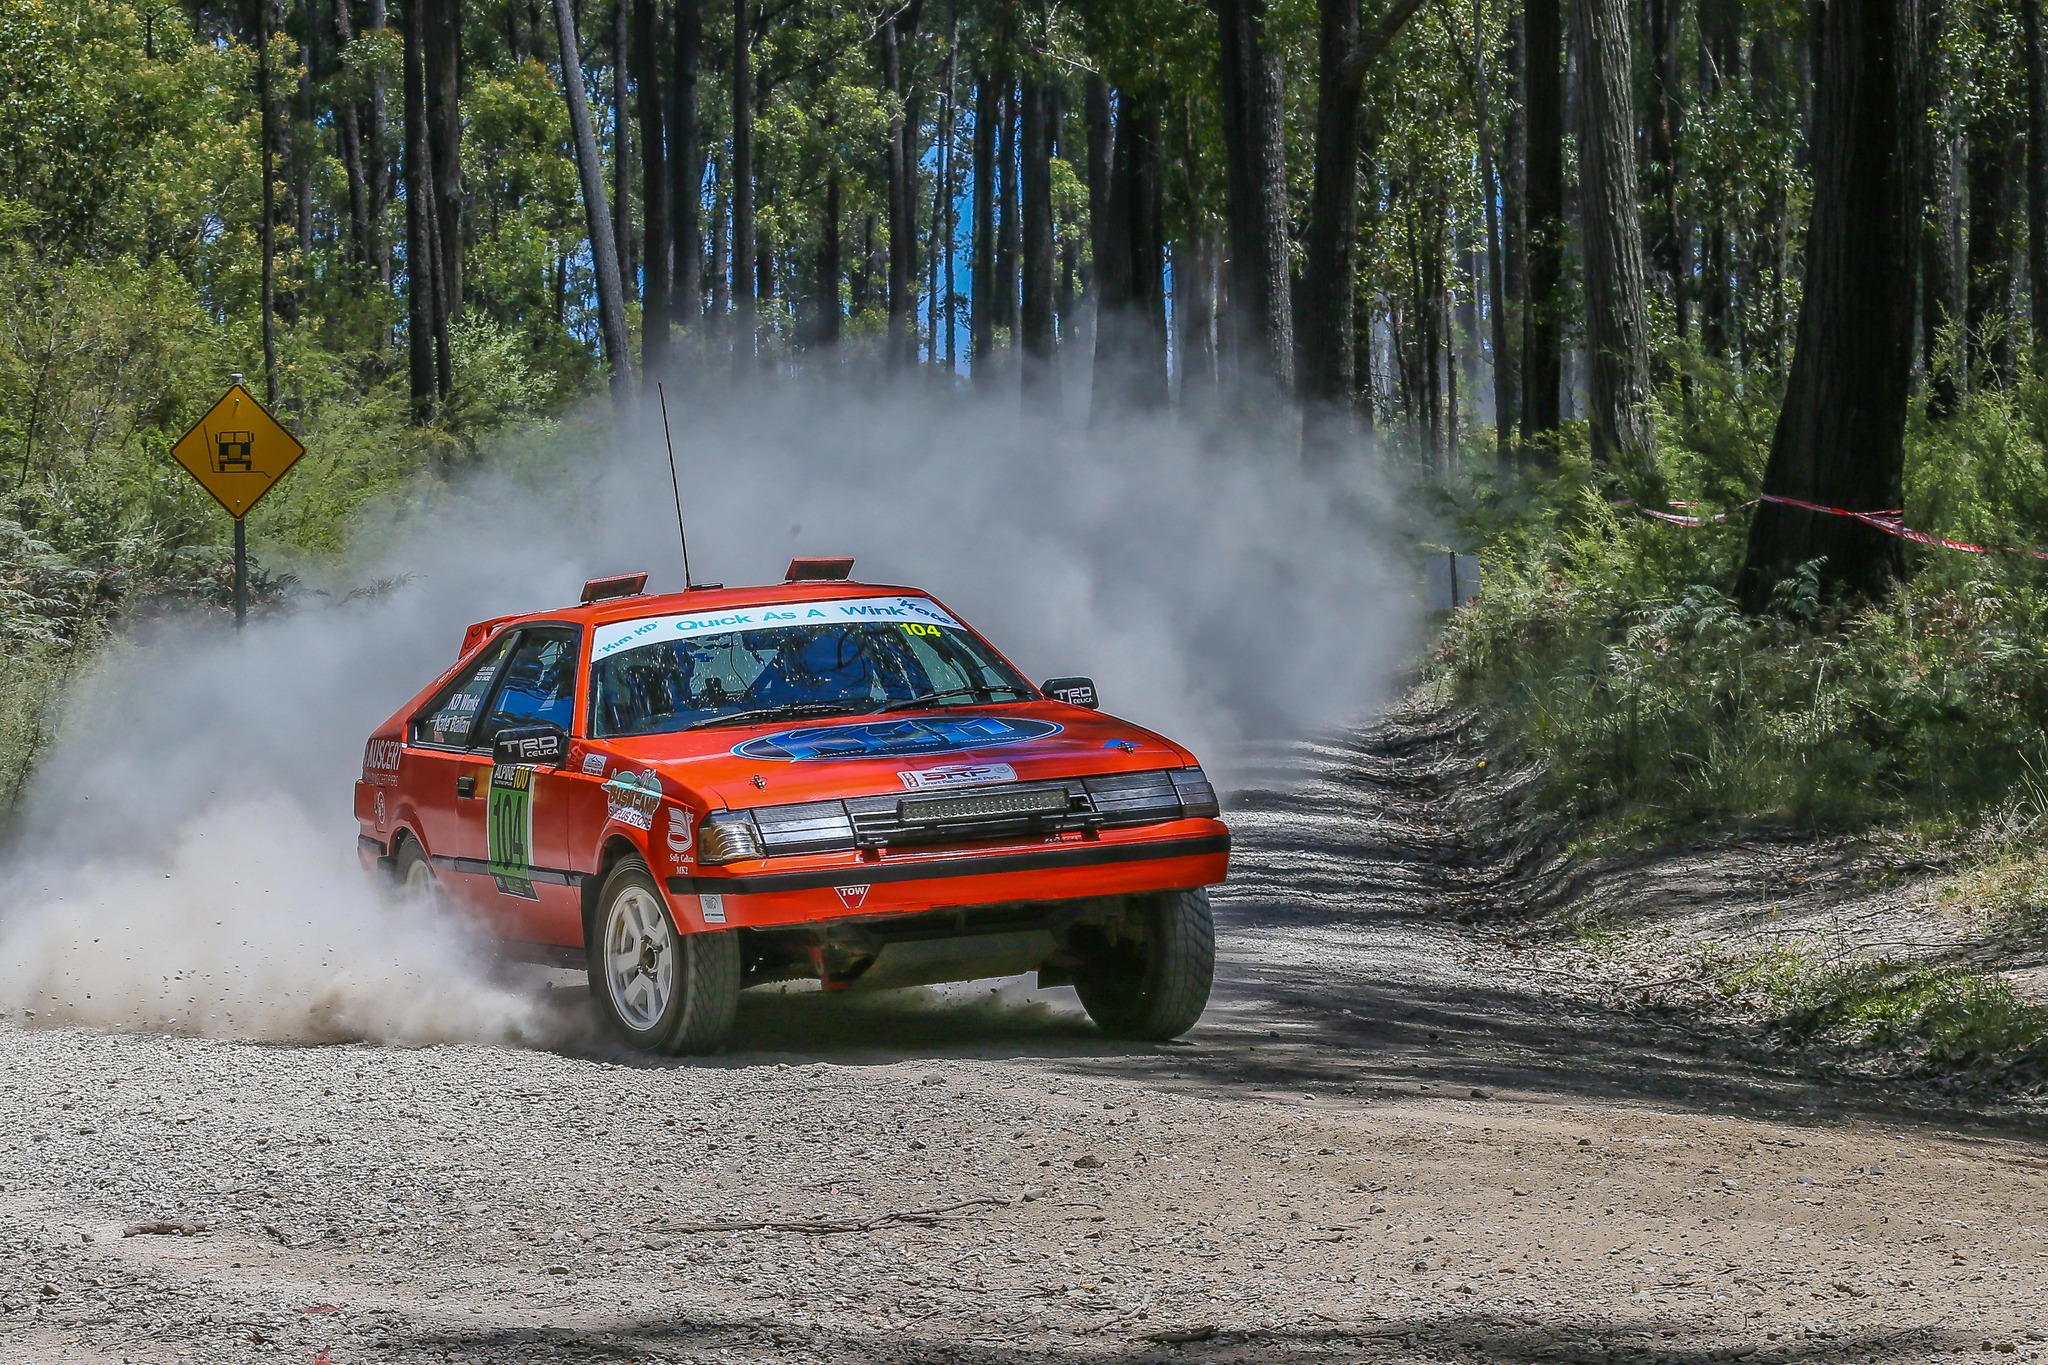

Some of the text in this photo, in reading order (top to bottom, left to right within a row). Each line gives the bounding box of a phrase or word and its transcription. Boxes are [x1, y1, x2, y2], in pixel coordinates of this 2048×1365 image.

[675, 614, 754, 632] Quick
[763, 611, 797, 622] As
[806, 608, 827, 618] A
[839, 606, 908, 617] Wink
[900, 623, 941, 638] 104
[448, 693, 463, 711] KD
[1053, 687, 1092, 704] TRD
[500, 735, 558, 757] TRD
[526, 748, 559, 757] CELICA
[494, 764, 531, 789] ALPINE 100
[922, 767, 991, 781] SRP
[629, 812, 652, 830] STORE
[494, 793, 524, 871] 104
[841, 887, 865, 897] TOW
